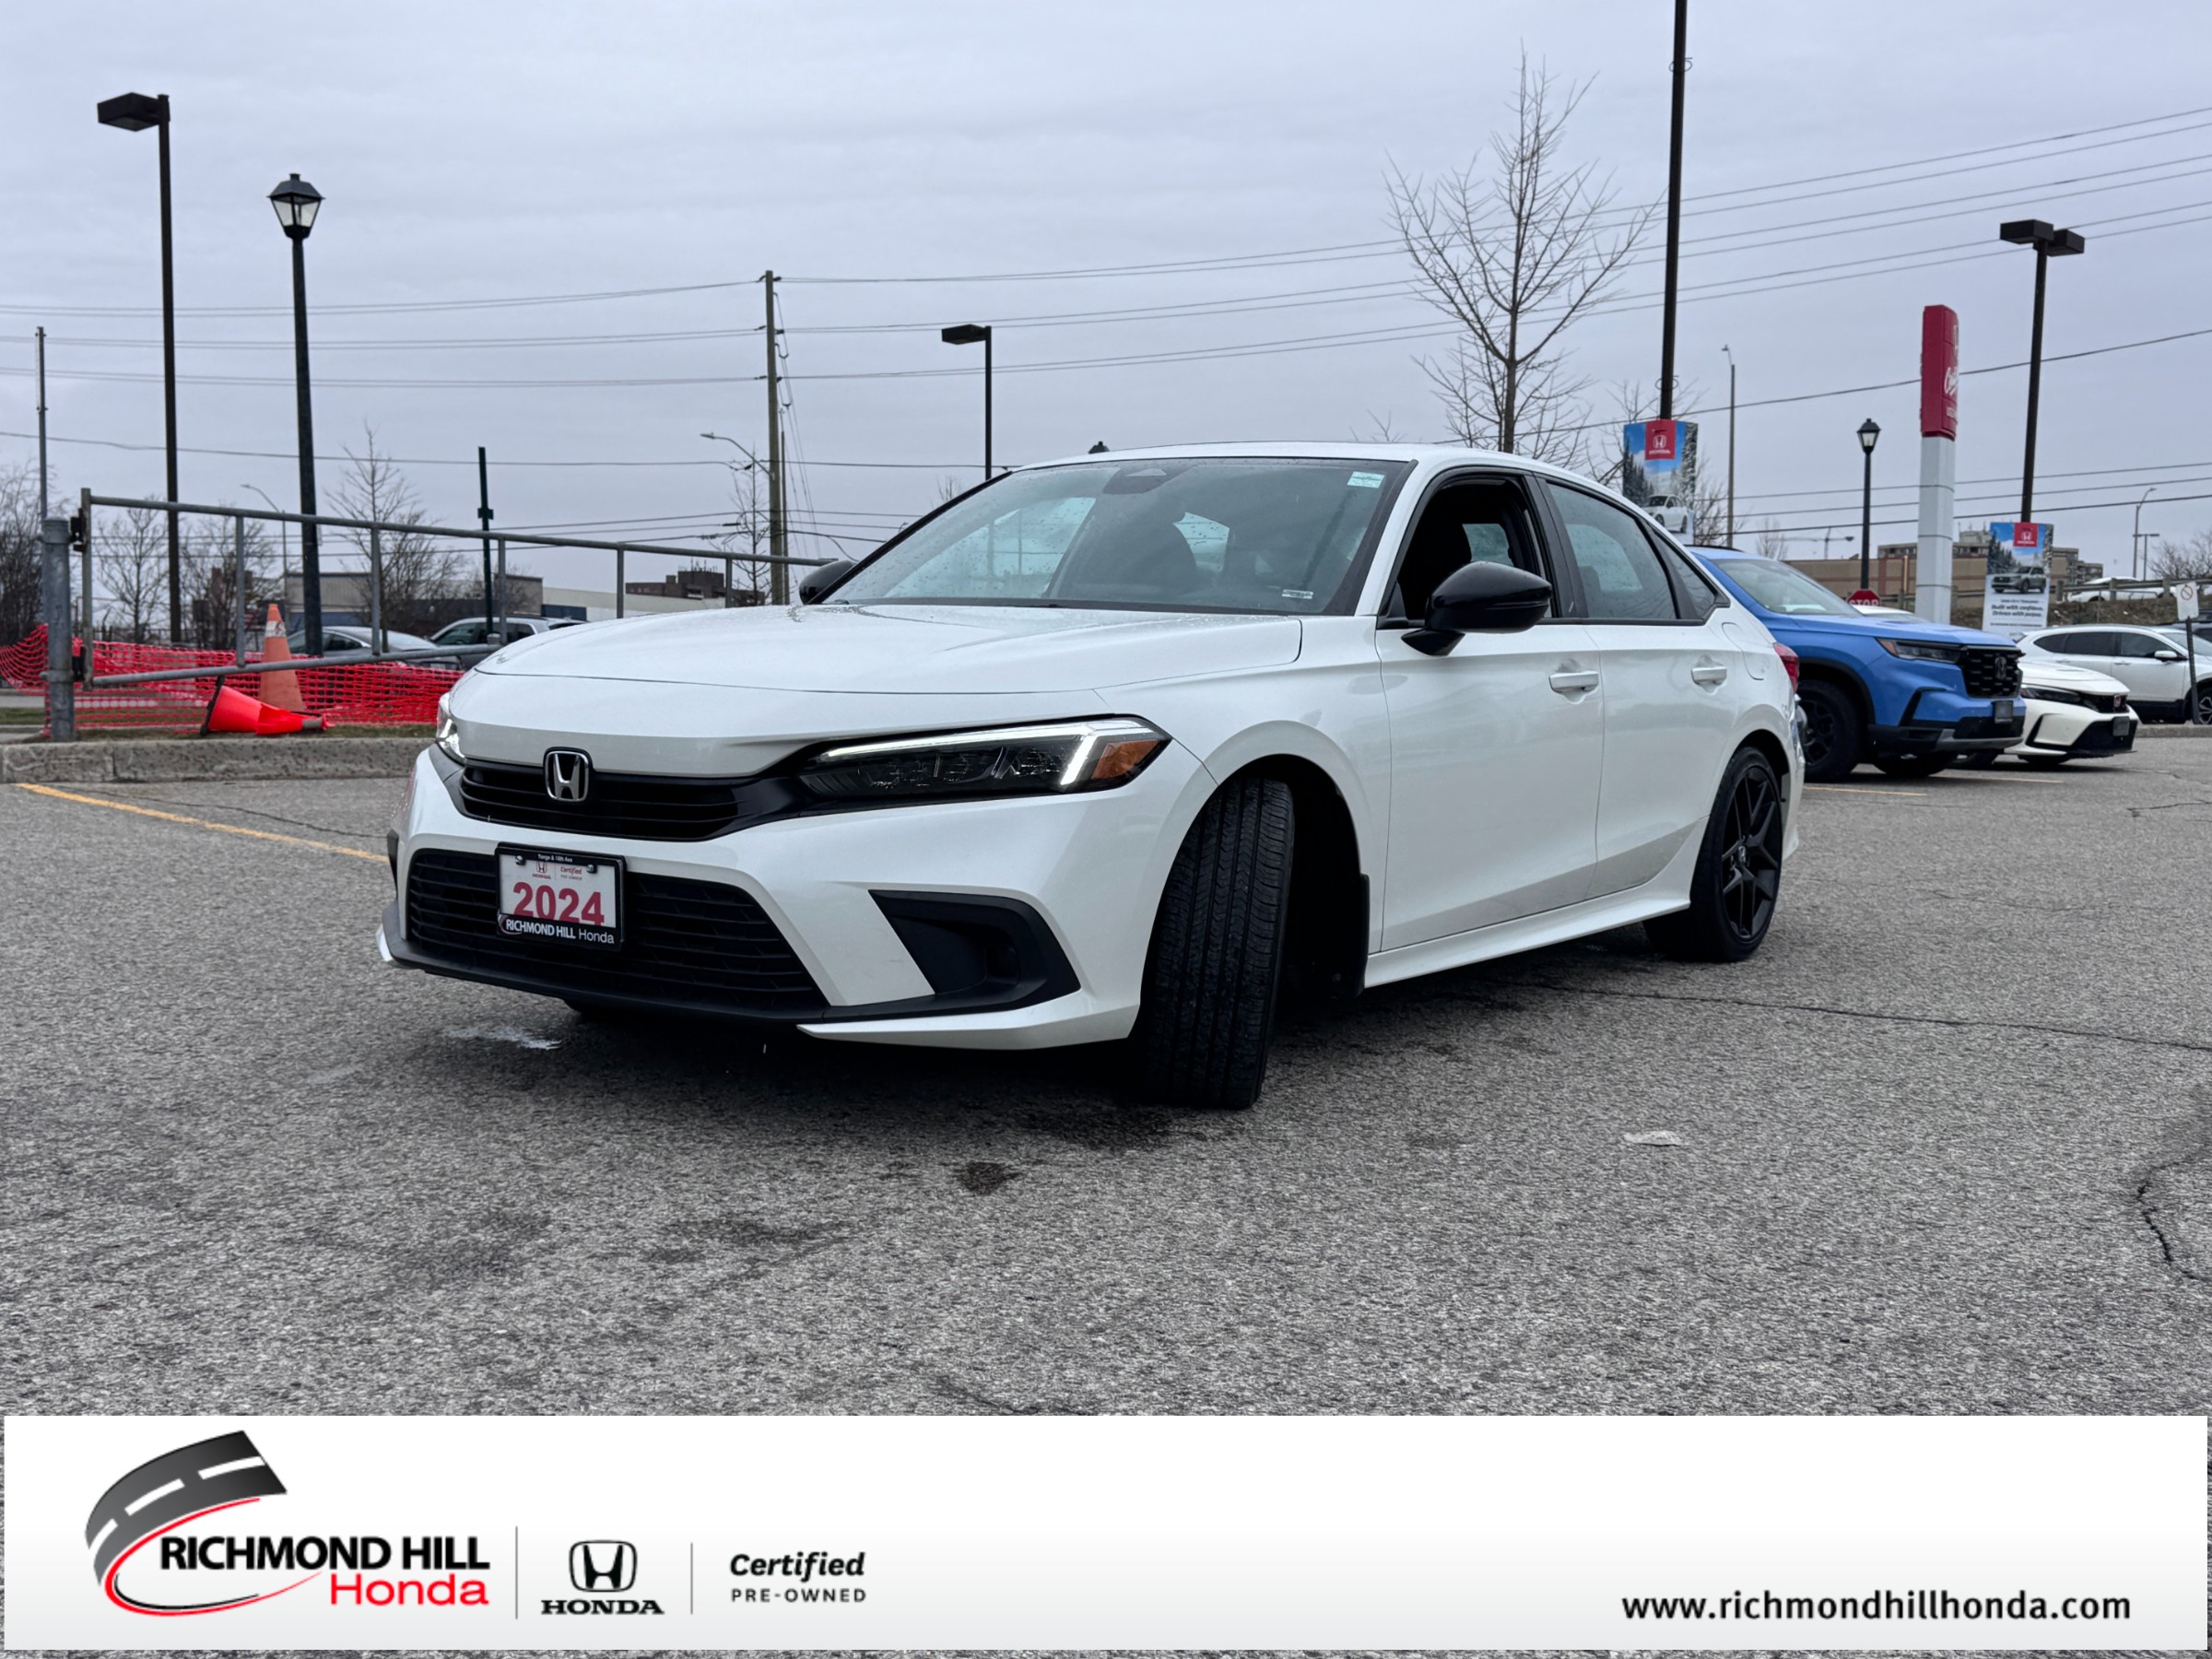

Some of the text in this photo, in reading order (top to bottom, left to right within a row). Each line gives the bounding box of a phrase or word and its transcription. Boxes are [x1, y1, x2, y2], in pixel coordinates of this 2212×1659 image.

[512, 881, 605, 926] 2024
[506, 919, 615, 945] RICHMOND HILL Honda
